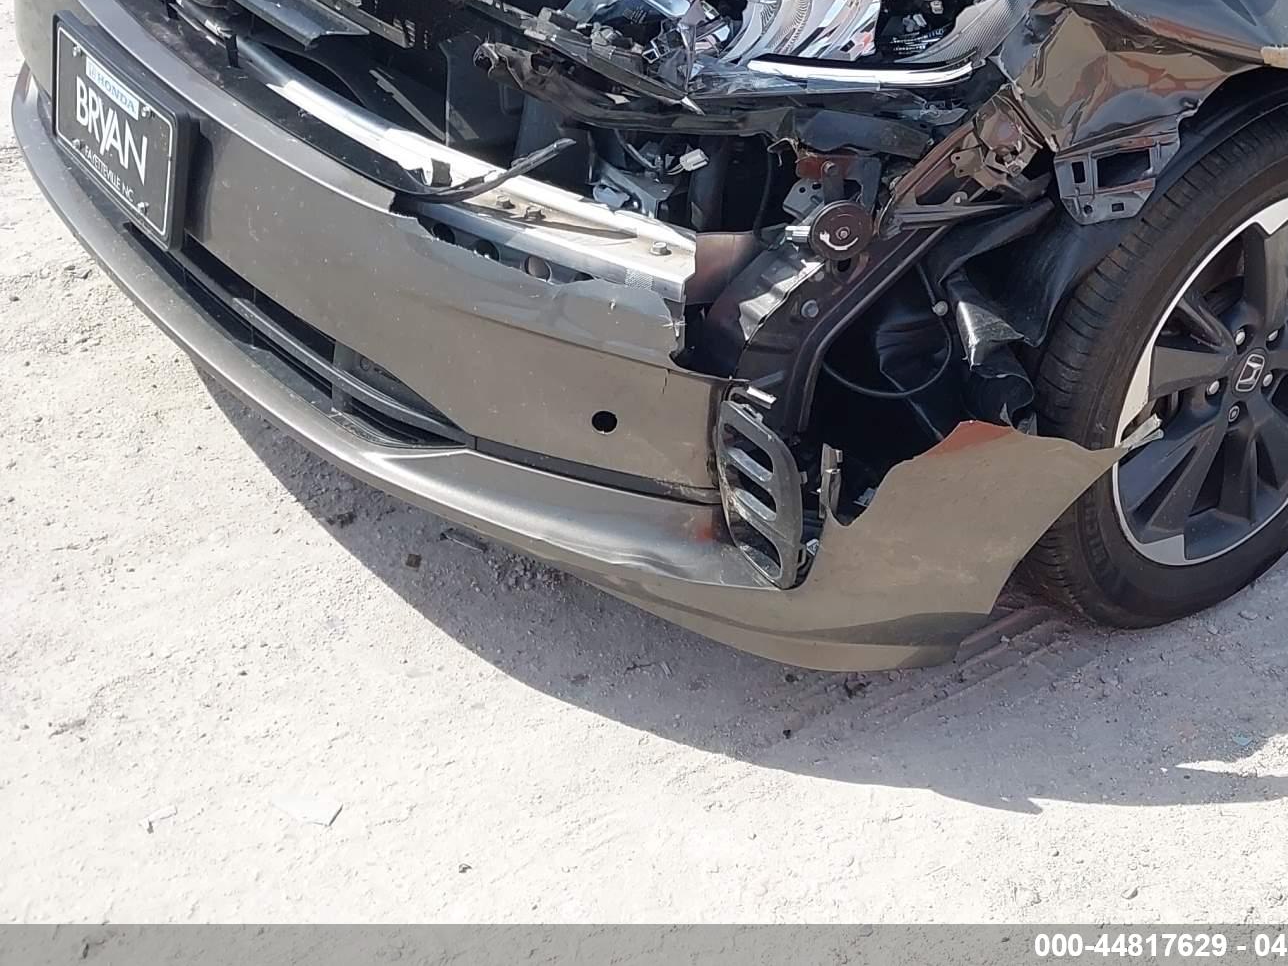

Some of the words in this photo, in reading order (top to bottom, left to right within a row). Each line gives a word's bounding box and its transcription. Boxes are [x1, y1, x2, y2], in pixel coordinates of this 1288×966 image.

[97, 72, 136, 113] HONDA
[76, 75, 148, 186] BRYAN
[84, 145, 121, 191] FAYETTEVILLE
[122, 181, 135, 203] NC
